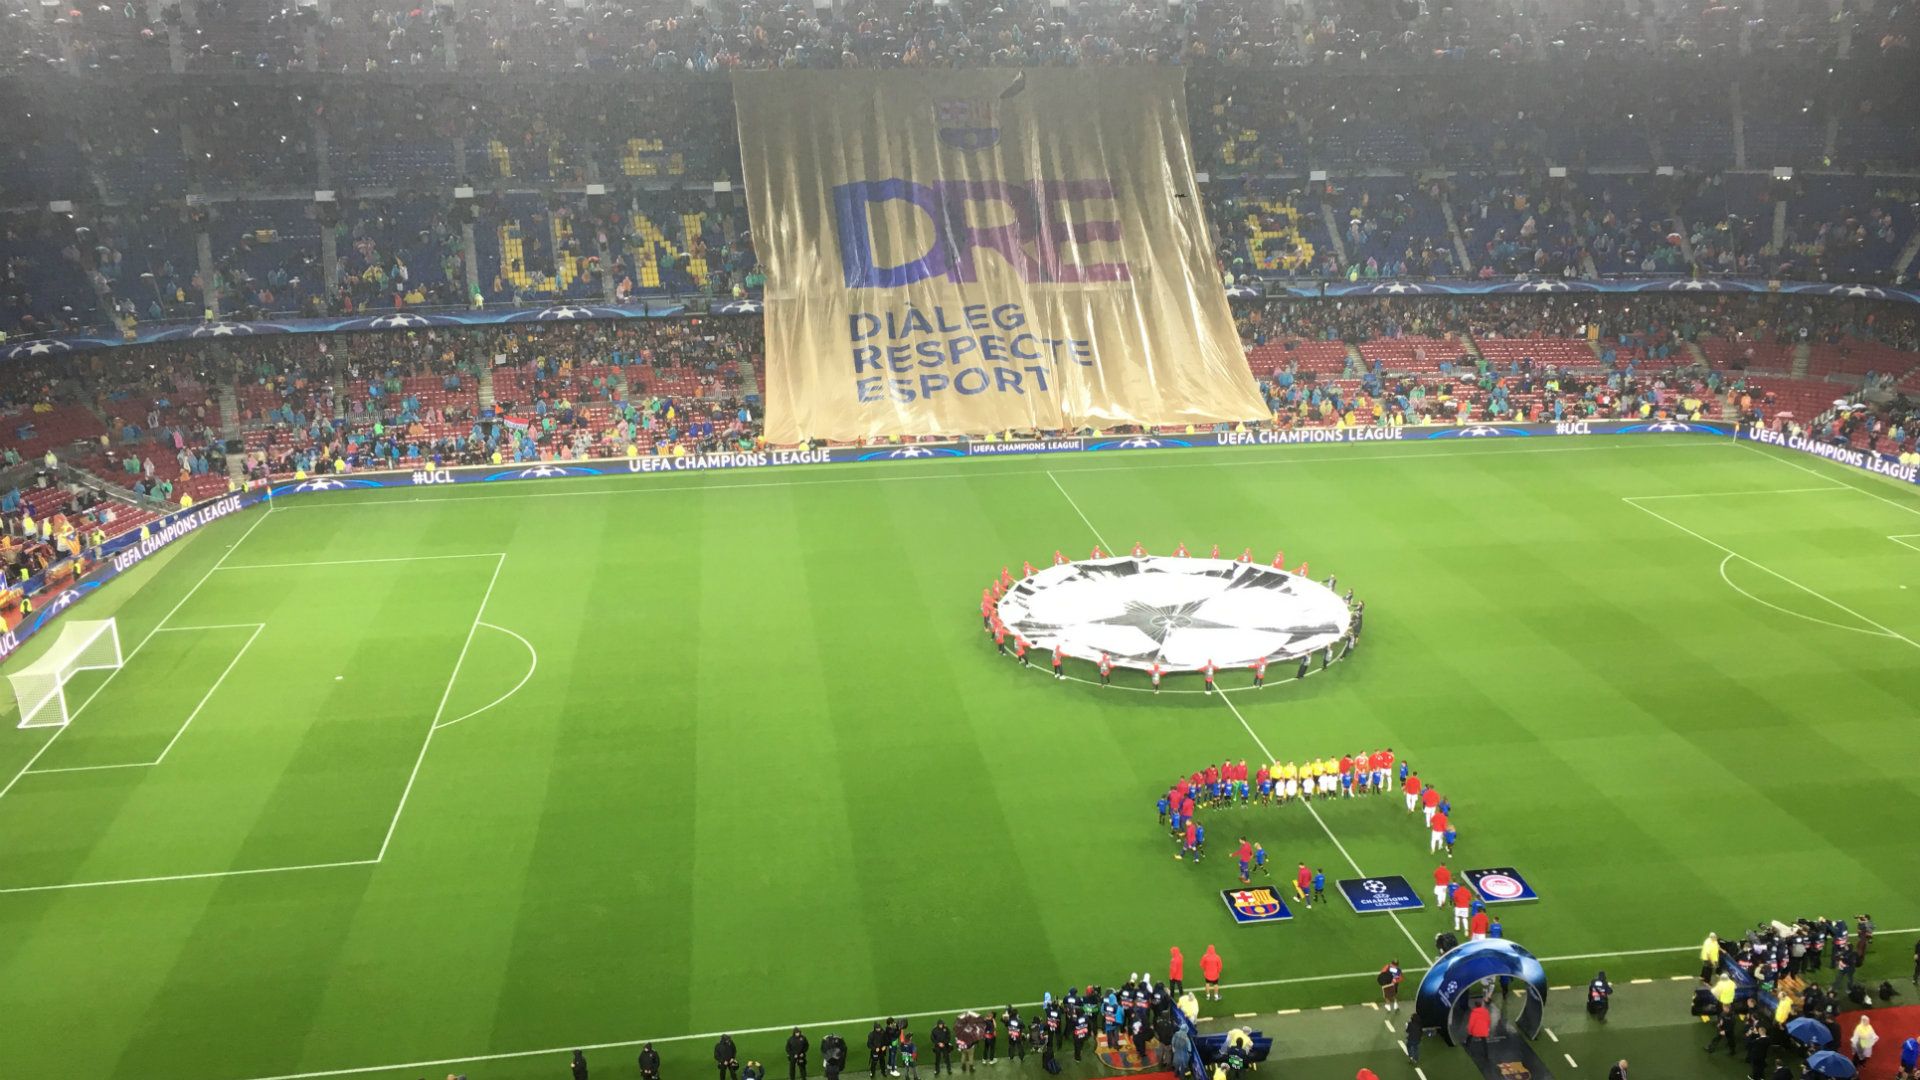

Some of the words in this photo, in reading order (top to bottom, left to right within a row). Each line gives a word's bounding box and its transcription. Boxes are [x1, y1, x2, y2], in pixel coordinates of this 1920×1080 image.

[833, 177, 1131, 288] DRE
[848, 301, 1025, 342] DIÀLEG
[852, 333, 1093, 374] RESPECTE
[856, 365, 1050, 404] ESPORT
[1217, 431, 1255, 445] UEFA
[1259, 429, 1344, 444] CHAMPIONS
[1348, 427, 1403, 441] LEAGUE
[1555, 422, 1591, 435] #UCL
[629, 457, 671, 472] UEFA
[674, 453, 768, 470] CHAMPIONS
[772, 449, 831, 465] LEAGUE
[973, 444, 995, 453] UEFA
[997, 442, 1045, 452] CHAMPIONS
[1048, 440, 1080, 450] LEAGUE
[1749, 427, 1785, 447] UEFA
[1788, 436, 1863, 467] CHAMPIONS
[1866, 457, 1917, 482] LEAGUE
[412, 470, 455, 485] #UCL
[113, 547, 142, 573] UEFA
[141, 514, 198, 556] CHAMPIONS
[198, 494, 242, 525] LEAGUE
[1360, 896, 1409, 905] CHAMPIONS
